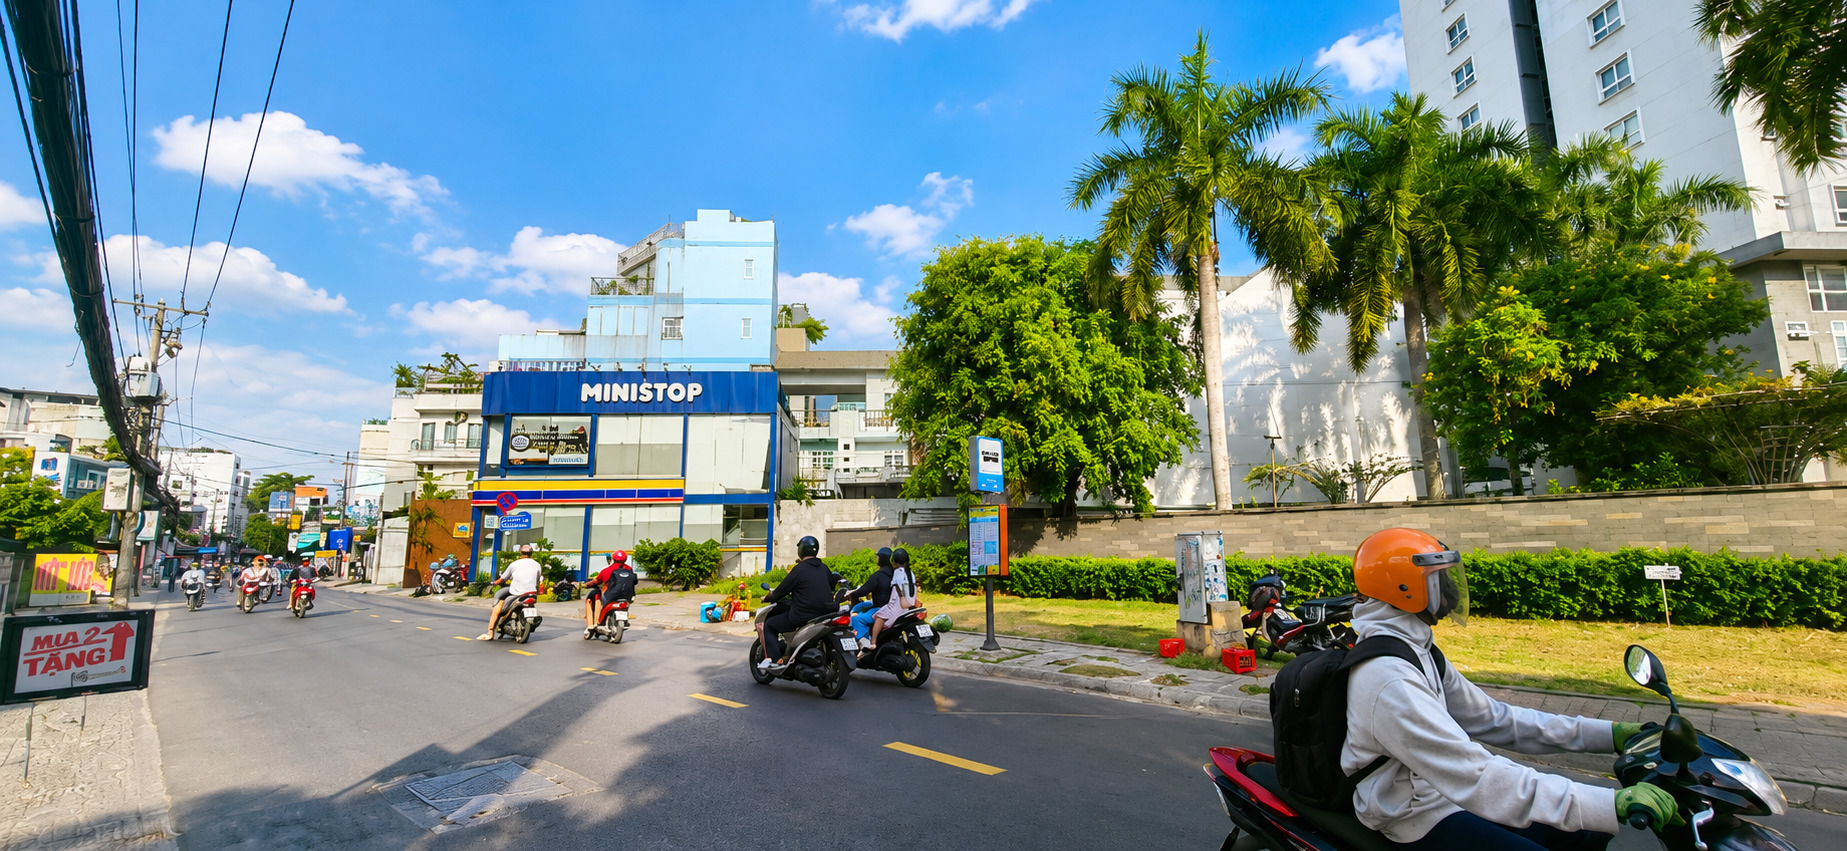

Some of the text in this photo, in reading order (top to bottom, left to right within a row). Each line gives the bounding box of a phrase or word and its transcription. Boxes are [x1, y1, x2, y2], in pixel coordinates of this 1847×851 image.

[580, 382, 703, 403] MINISTOP
[31, 626, 106, 651] MUA 2
[23, 647, 105, 677] TẶNG
